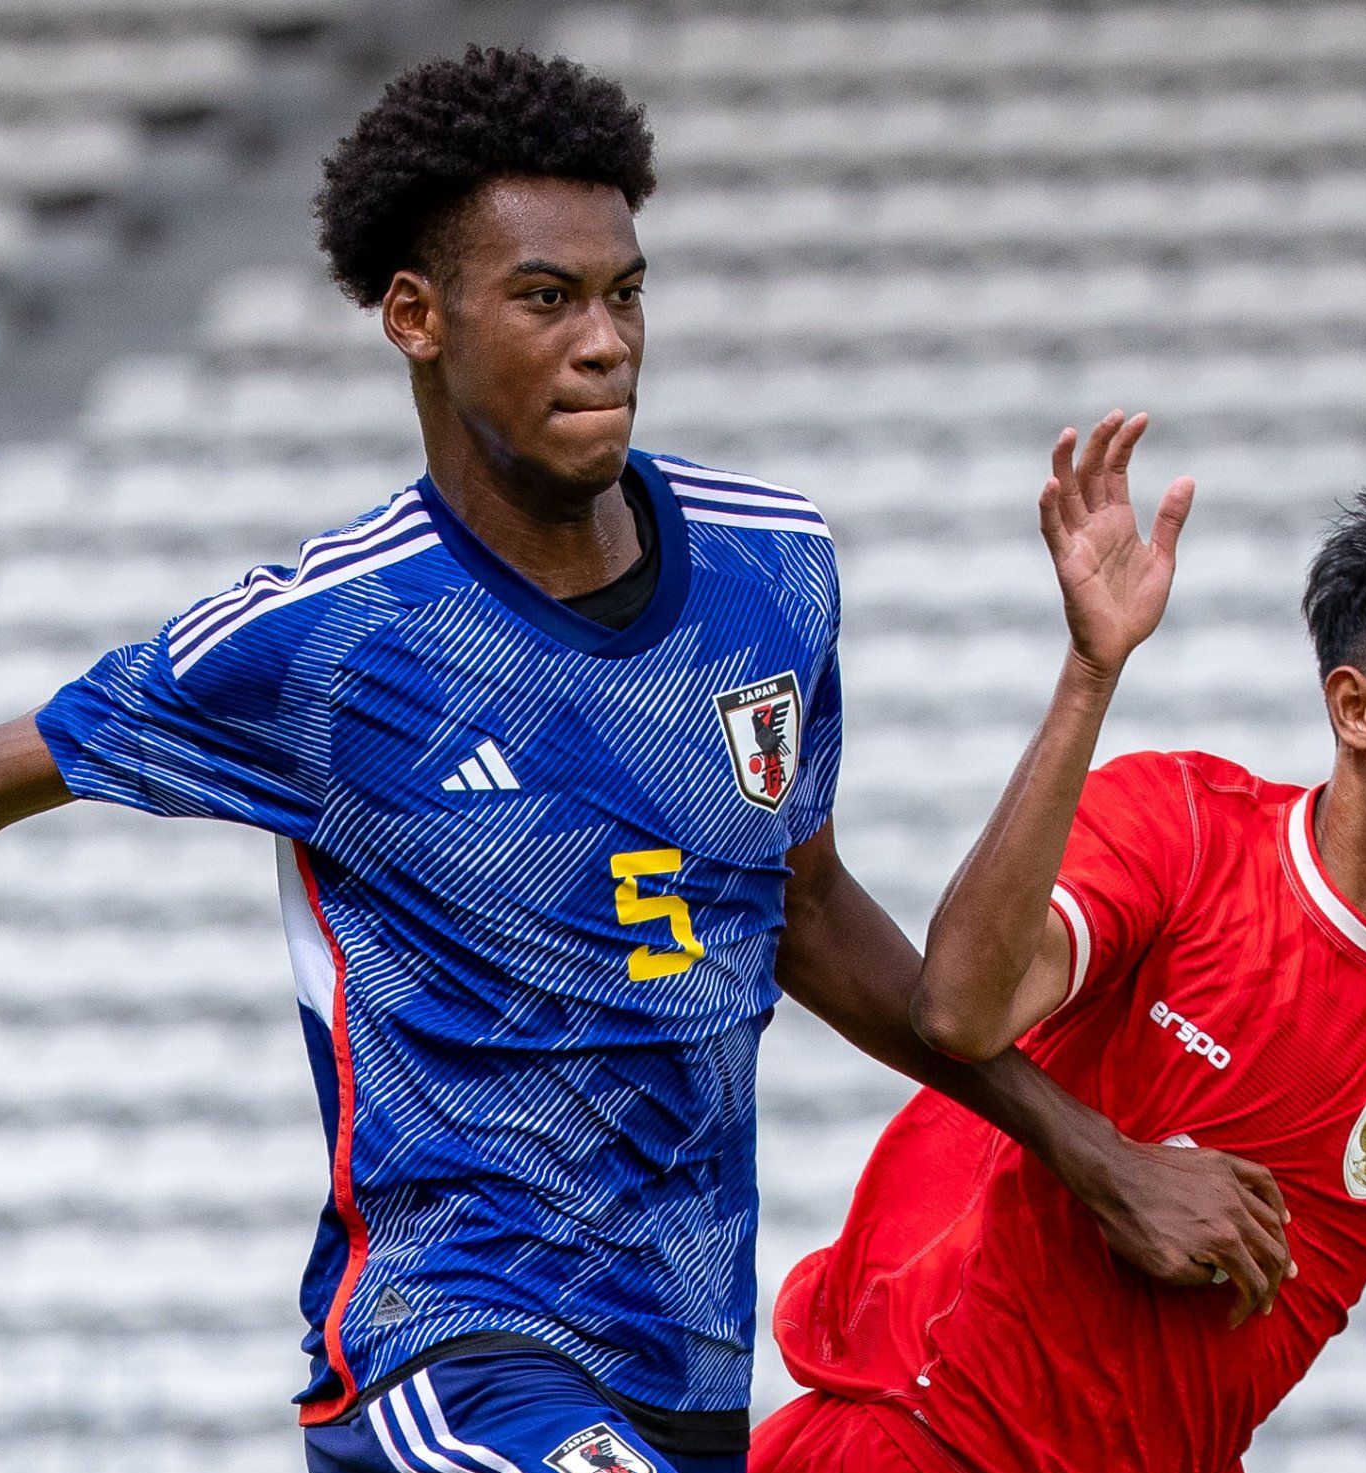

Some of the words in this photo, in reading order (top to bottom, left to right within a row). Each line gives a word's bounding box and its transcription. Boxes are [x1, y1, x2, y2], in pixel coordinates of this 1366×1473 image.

[738, 683, 778, 704] JAPAN
[610, 848, 705, 982] 5
[1149, 1000, 1231, 1070] erspo
[561, 1431, 596, 1454] JAPAN
